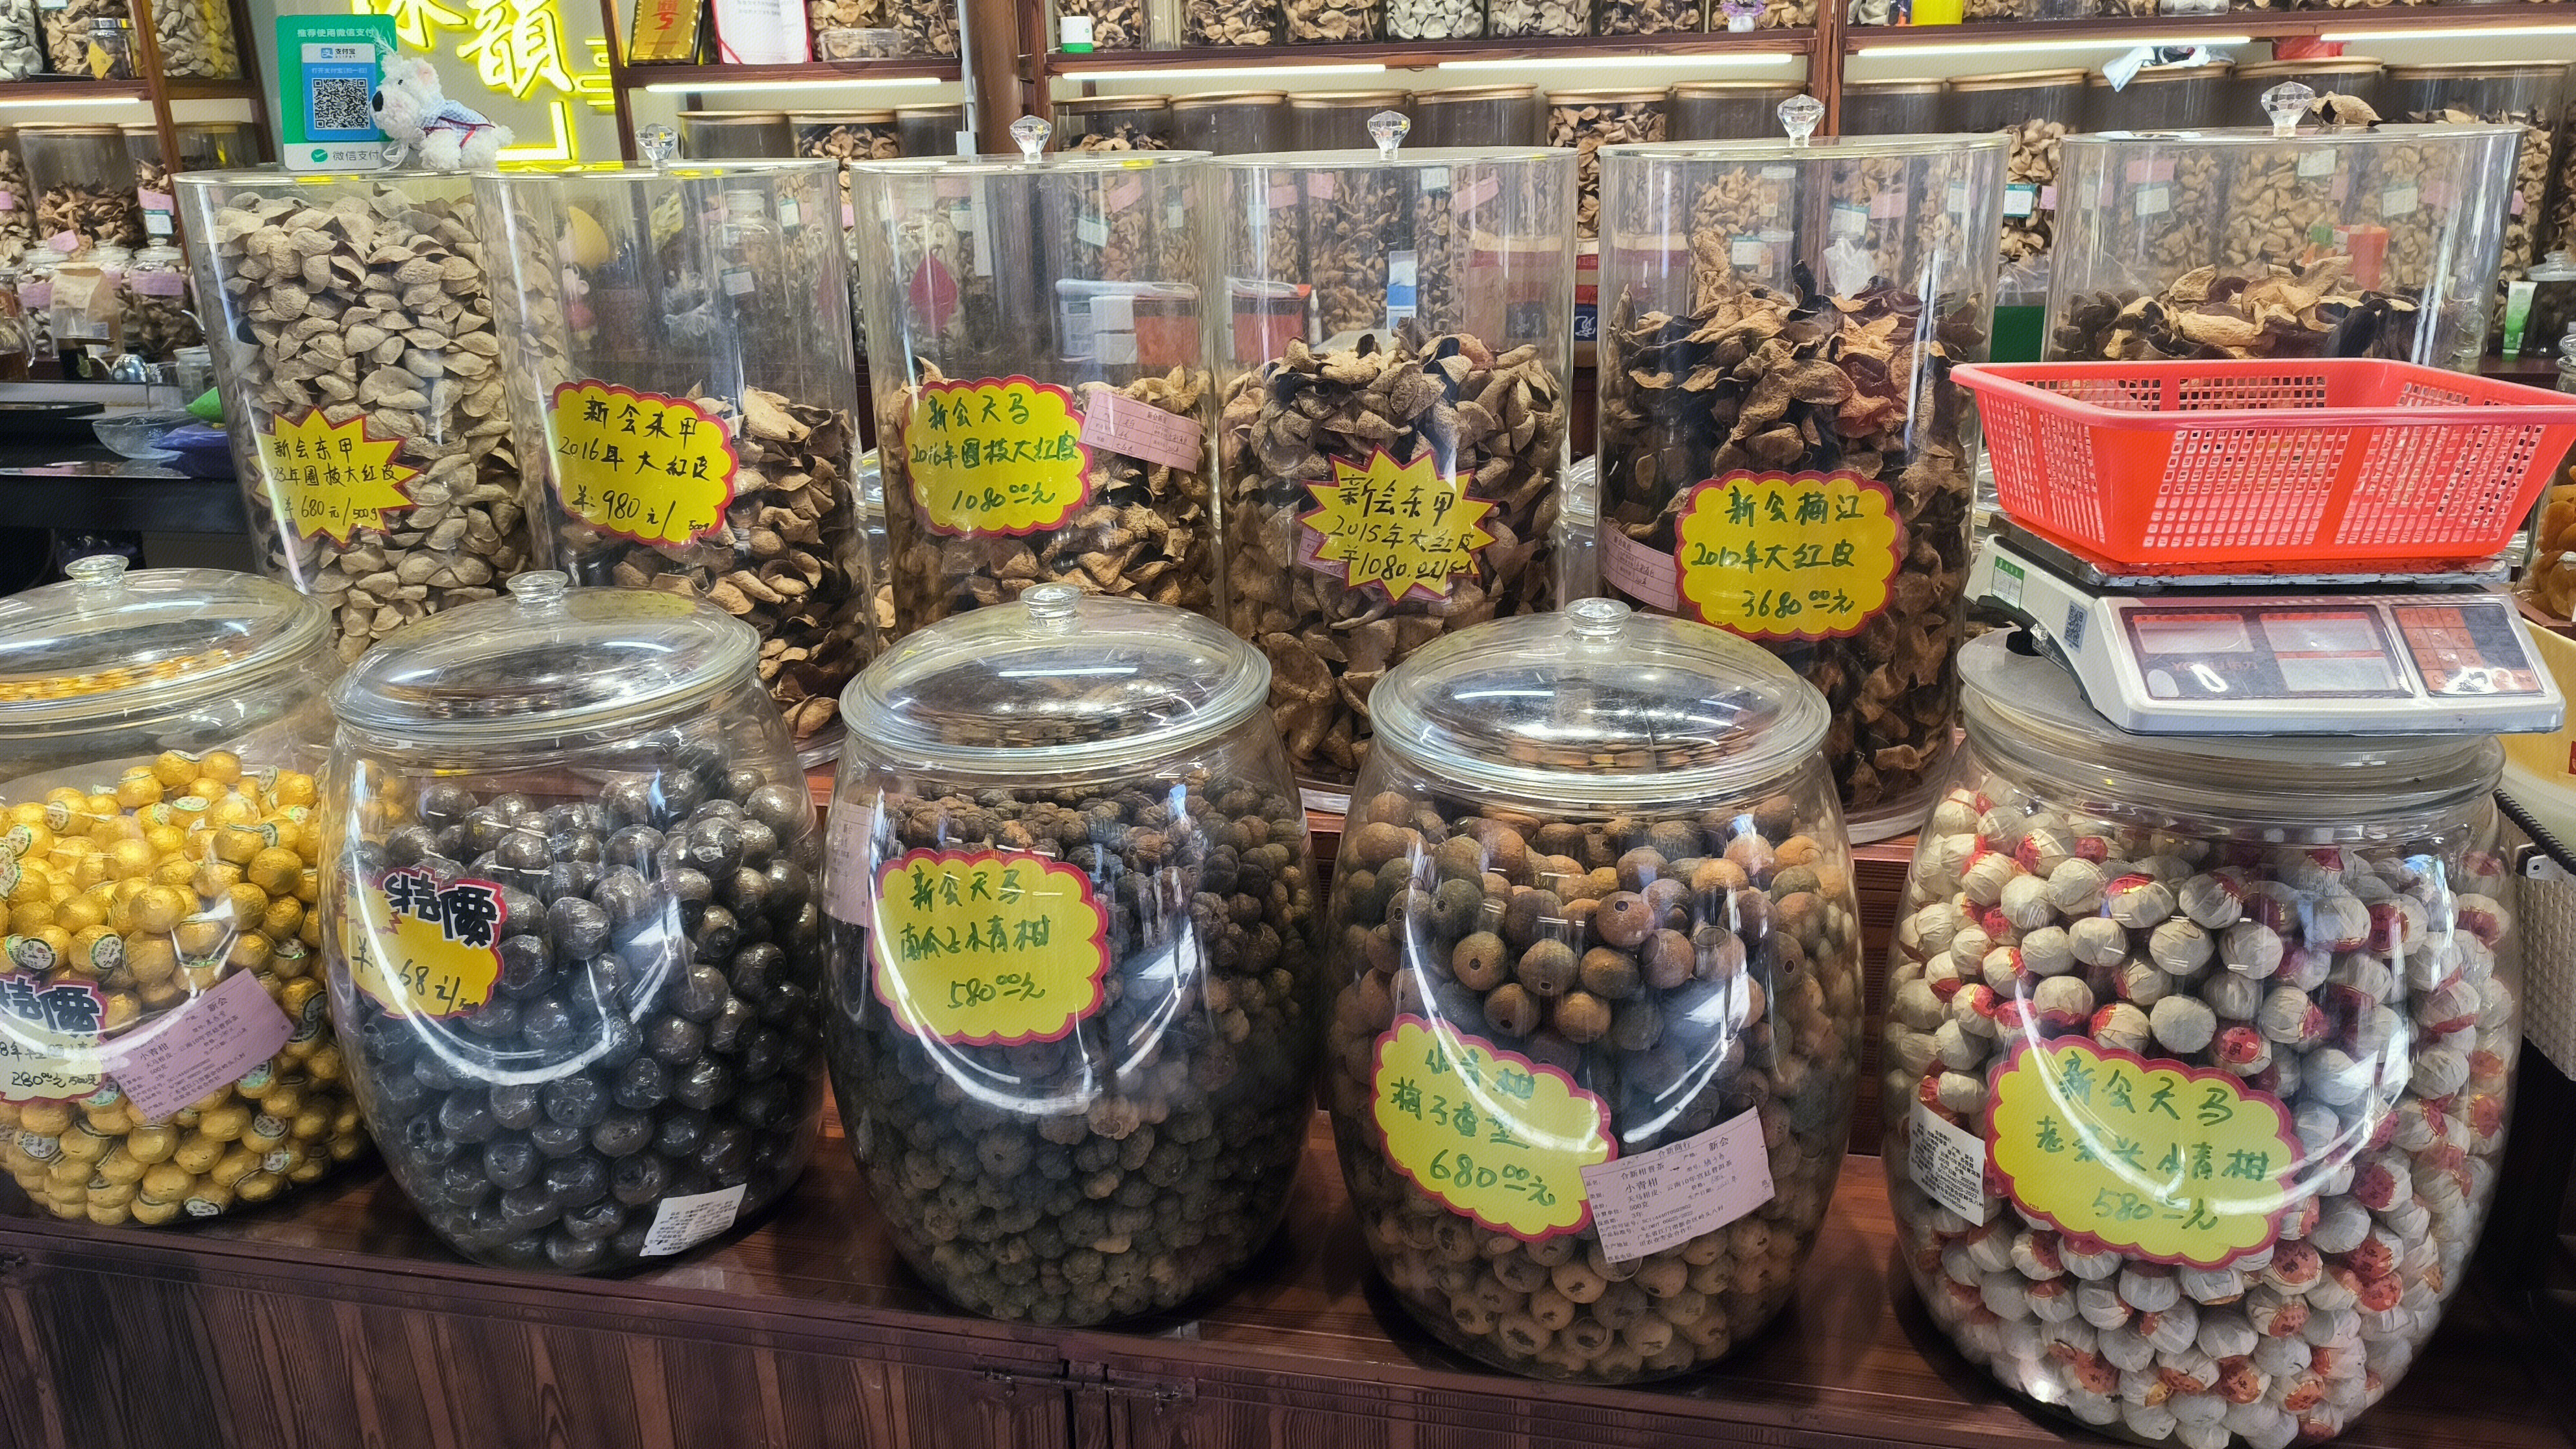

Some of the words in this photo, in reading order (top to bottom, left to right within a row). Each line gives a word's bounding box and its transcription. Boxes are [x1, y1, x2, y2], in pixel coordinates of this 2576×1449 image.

[332, 150, 379, 161] 微信支付
[208, 997, 229, 1012] 新会
[140, 1042, 169, 1061] 小青柑
[1708, 1136, 1729, 1152] 新会
[1625, 1176, 1659, 1193] 小青柑
